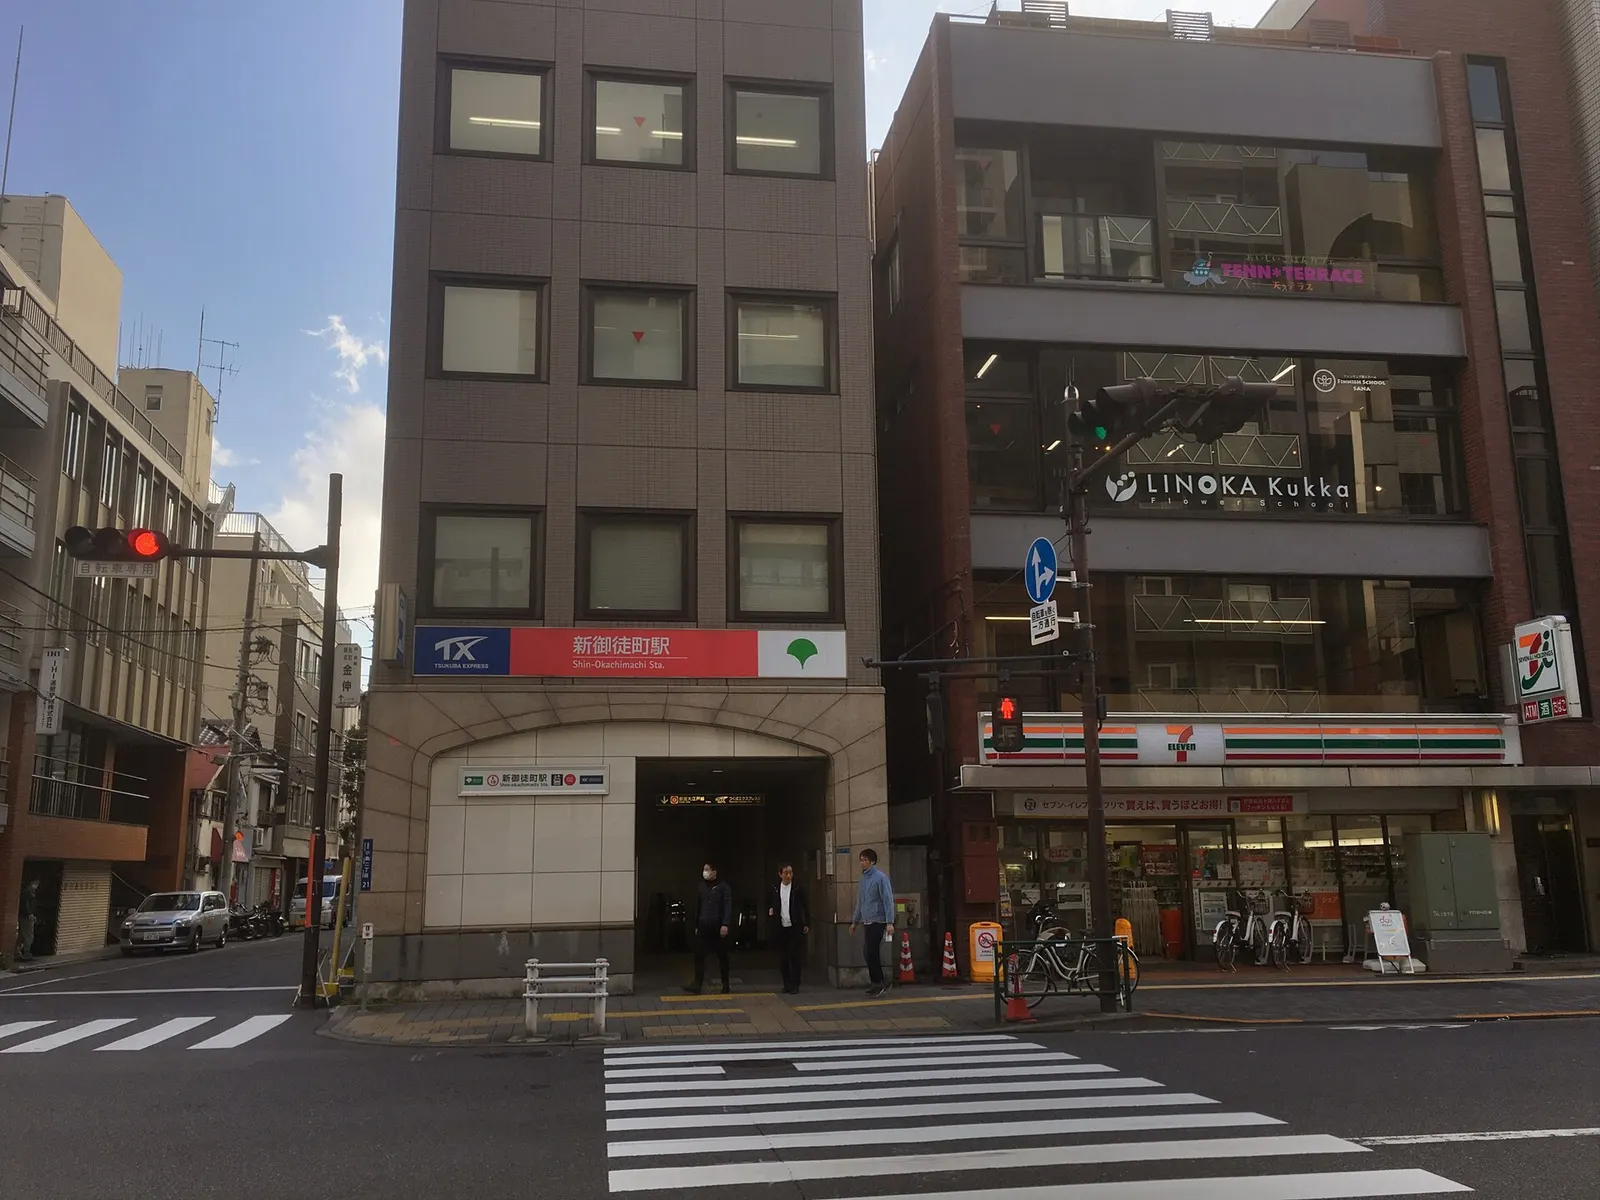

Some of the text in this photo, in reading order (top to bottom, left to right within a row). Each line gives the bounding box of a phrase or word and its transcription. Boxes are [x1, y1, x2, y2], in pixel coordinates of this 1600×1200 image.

[1147, 474, 1349, 498] LINOKA Kukka
[81, 563, 154, 575] 自転車専用
[1031, 606, 1056, 620] 自転車を除く
[1032, 616, 1056, 630] 一方通行
[434, 636, 489, 661] TX
[573, 636, 670, 655] 新御徒町駅
[572, 660, 665, 669] Shin-Okachimachi Sta.
[342, 664, 353, 692] 金伸
[1525, 704, 1538, 718] ATM
[1539, 701, 1550, 717] 酒
[502, 773, 549, 783] 新御徒町駅
